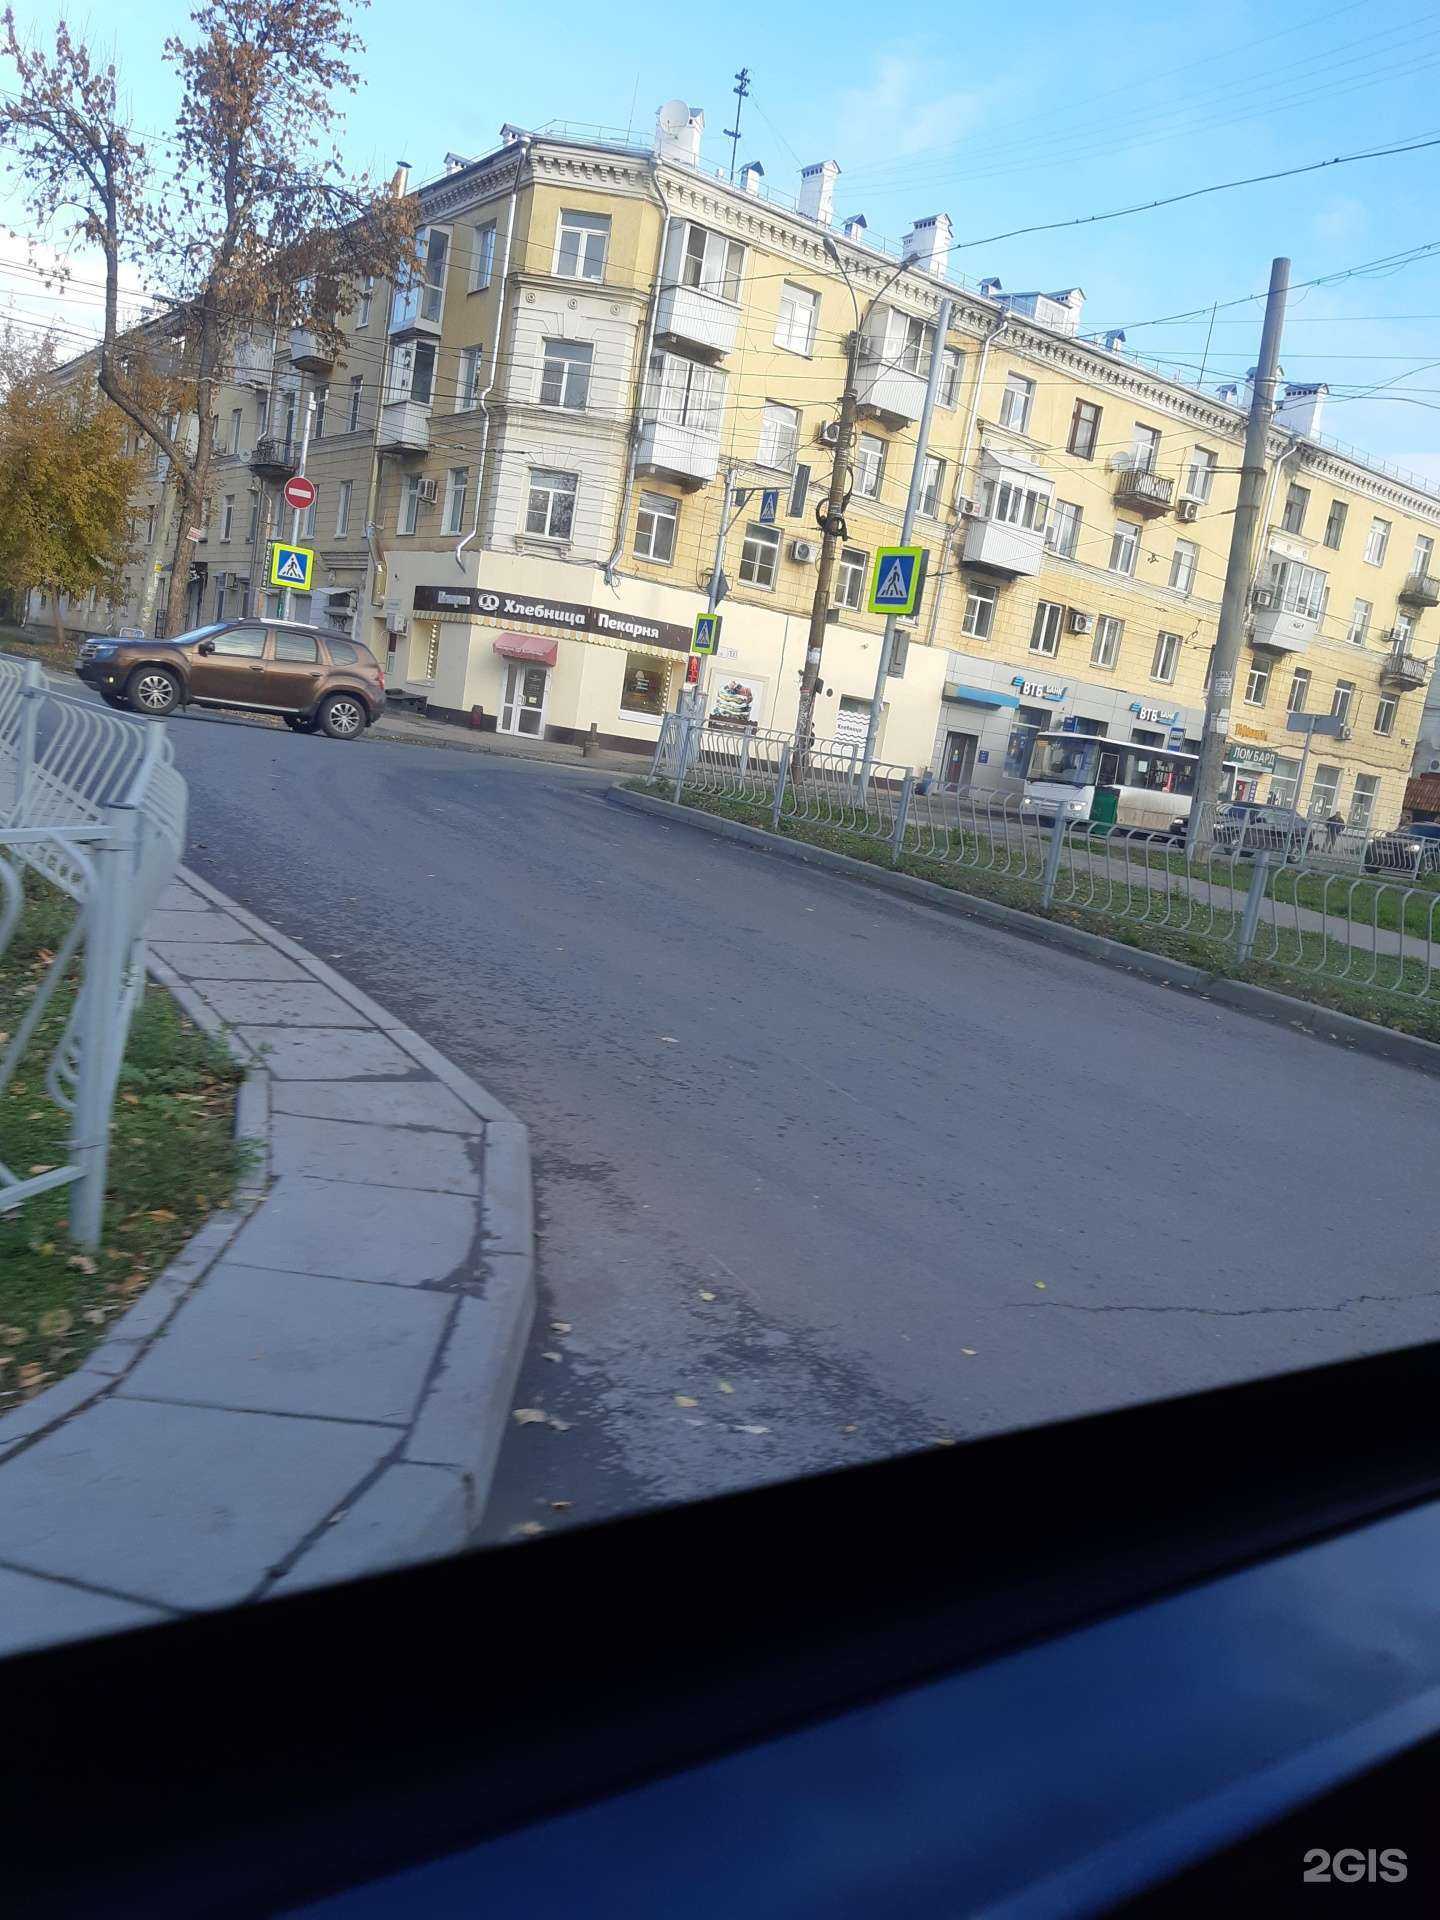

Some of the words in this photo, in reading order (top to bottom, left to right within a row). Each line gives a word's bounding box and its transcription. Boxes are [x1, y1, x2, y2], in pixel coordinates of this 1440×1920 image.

[503, 599, 585, 625] Хлебница
[597, 613, 660, 639] Пекарня
[1022, 681, 1043, 697] ВТБ
[1139, 707, 1158, 722] ВТБ
[1232, 747, 1276, 766] ЛОМБАРД
